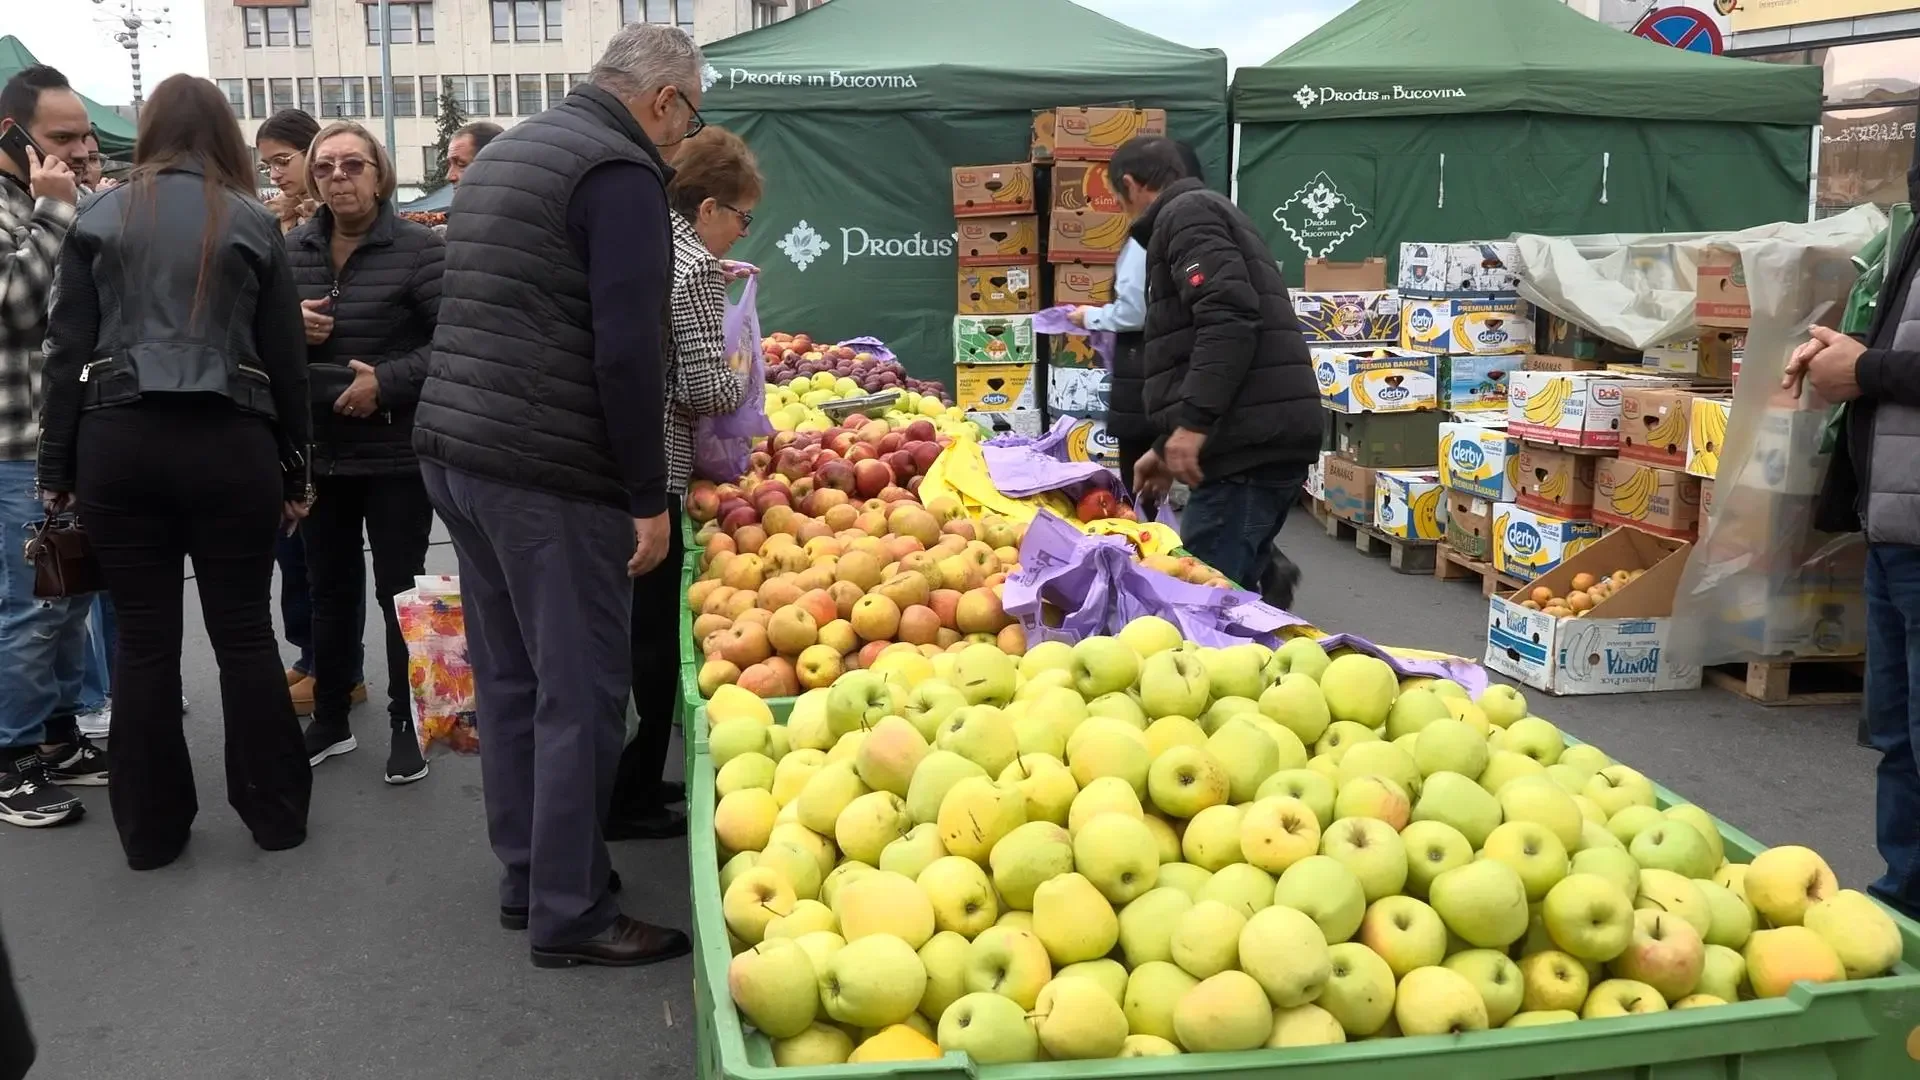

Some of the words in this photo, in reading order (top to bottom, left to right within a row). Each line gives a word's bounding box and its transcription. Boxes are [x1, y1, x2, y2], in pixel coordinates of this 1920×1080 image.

[730, 68, 802, 89] Produs
[808, 72, 825, 86] in
[829, 70, 917, 88] Bucovina
[1319, 86, 1379, 106] Produs
[1392, 85, 1467, 100] Bucovina
[839, 227, 953, 265] Produs
[1070, 275, 1090, 284] Dole
[1457, 304, 1493, 312] PREMIUM
[1479, 331, 1507, 342] derby
[1356, 361, 1392, 369] PREMIUM
[1393, 359, 1429, 368] BANANAS
[983, 394, 1008, 404] derby
[1380, 388, 1408, 399] derby
[1598, 388, 1620, 398] Dole
[1453, 440, 1483, 468] derby
[1330, 464, 1354, 481] BANANAS
[1509, 522, 1540, 554] derby
[1505, 563, 1529, 578] PREMIUM
[1506, 610, 1528, 635] BONITA
[1604, 648, 1661, 675] BONITA
